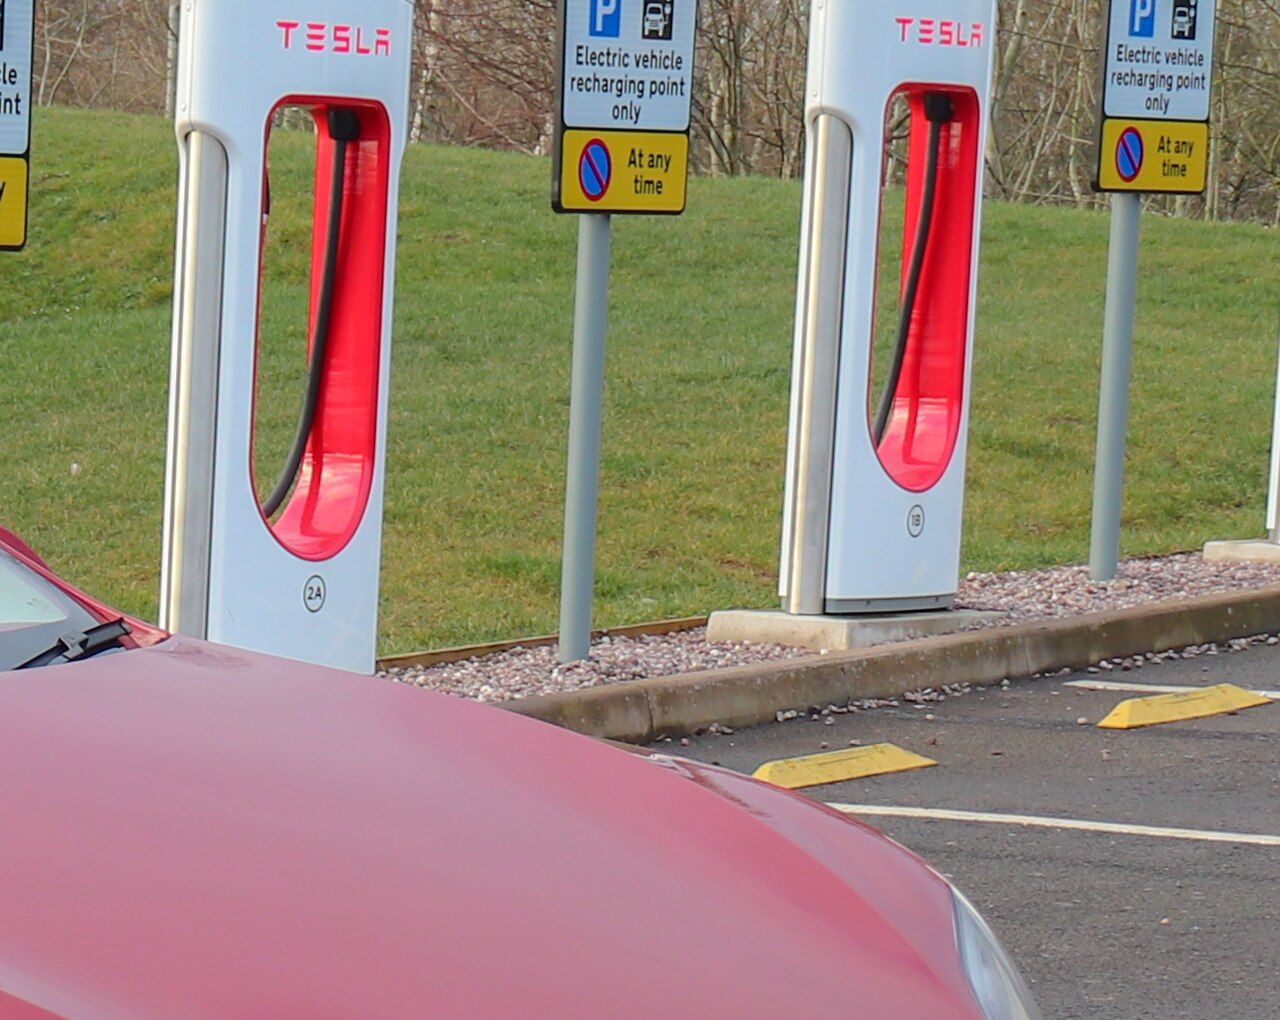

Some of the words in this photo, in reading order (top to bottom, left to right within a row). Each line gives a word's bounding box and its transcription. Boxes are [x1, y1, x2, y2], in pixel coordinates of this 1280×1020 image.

[276, 21, 390, 56] TESLA
[895, 17, 983, 47] TESLA
[575, 45, 630, 68] Electric
[634, 49, 683, 70] vehicle
[1116, 44, 1161, 64] Electric
[1165, 47, 1204, 66] vehicle
[570, 73, 645, 99] recharging
[649, 77, 685, 99] point
[1111, 69, 1173, 91] recharging
[1176, 73, 1206, 91] point
[612, 101, 642, 124] only
[1145, 93, 1170, 114] only
[1157, 135, 1171, 153] At
[1174, 139, 1194, 157] any
[627, 148, 644, 169] At
[647, 153, 671, 173] any
[1162, 159, 1187, 177] time
[634, 175, 663, 195] time
[307, 586, 322, 600] 2A
